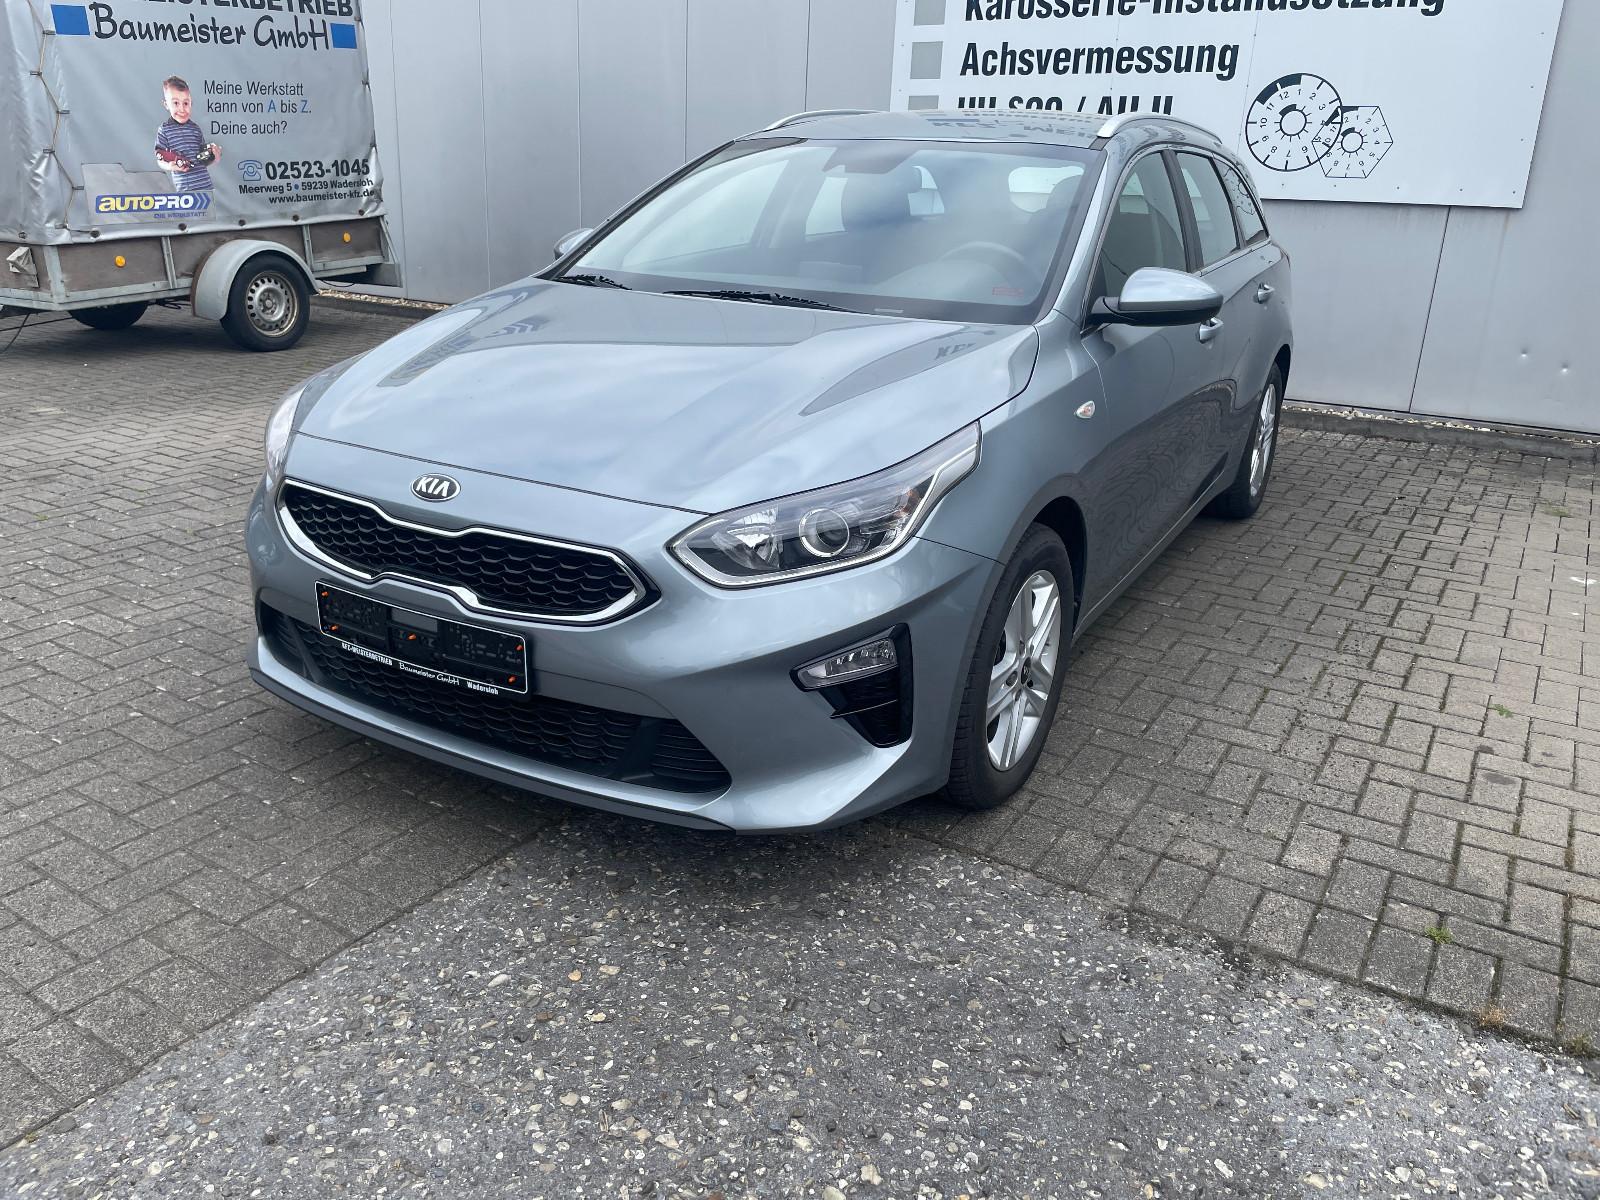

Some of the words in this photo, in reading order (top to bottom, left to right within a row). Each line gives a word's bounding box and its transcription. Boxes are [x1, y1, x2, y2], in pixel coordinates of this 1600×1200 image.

[89, 2, 246, 45] Baumeister
[254, 15, 329, 50] GmbH
[959, 42, 1240, 82] Achsvermessung
[204, 80, 242, 95] Meine
[246, 80, 304, 96] Werkstatt
[1279, 91, 1290, 100] 12
[207, 99, 237, 113] kann
[241, 102, 264, 113] von
[267, 99, 277, 113] A
[280, 100, 297, 113] bis
[300, 99, 312, 113] Z.
[211, 121, 247, 135] Deine
[251, 120, 288, 135] auch?
[1260, 117, 1268, 128] 10
[265, 159, 370, 181] 02523-1045
[238, 184, 284, 195] Meerweg
[286, 183, 292, 192] 5
[301, 180, 328, 191] 59239
[330, 179, 374, 189] Wadersloh
[269, 189, 375, 204] www.baumeister-kfz.de
[415, 476, 451, 497] KIA
